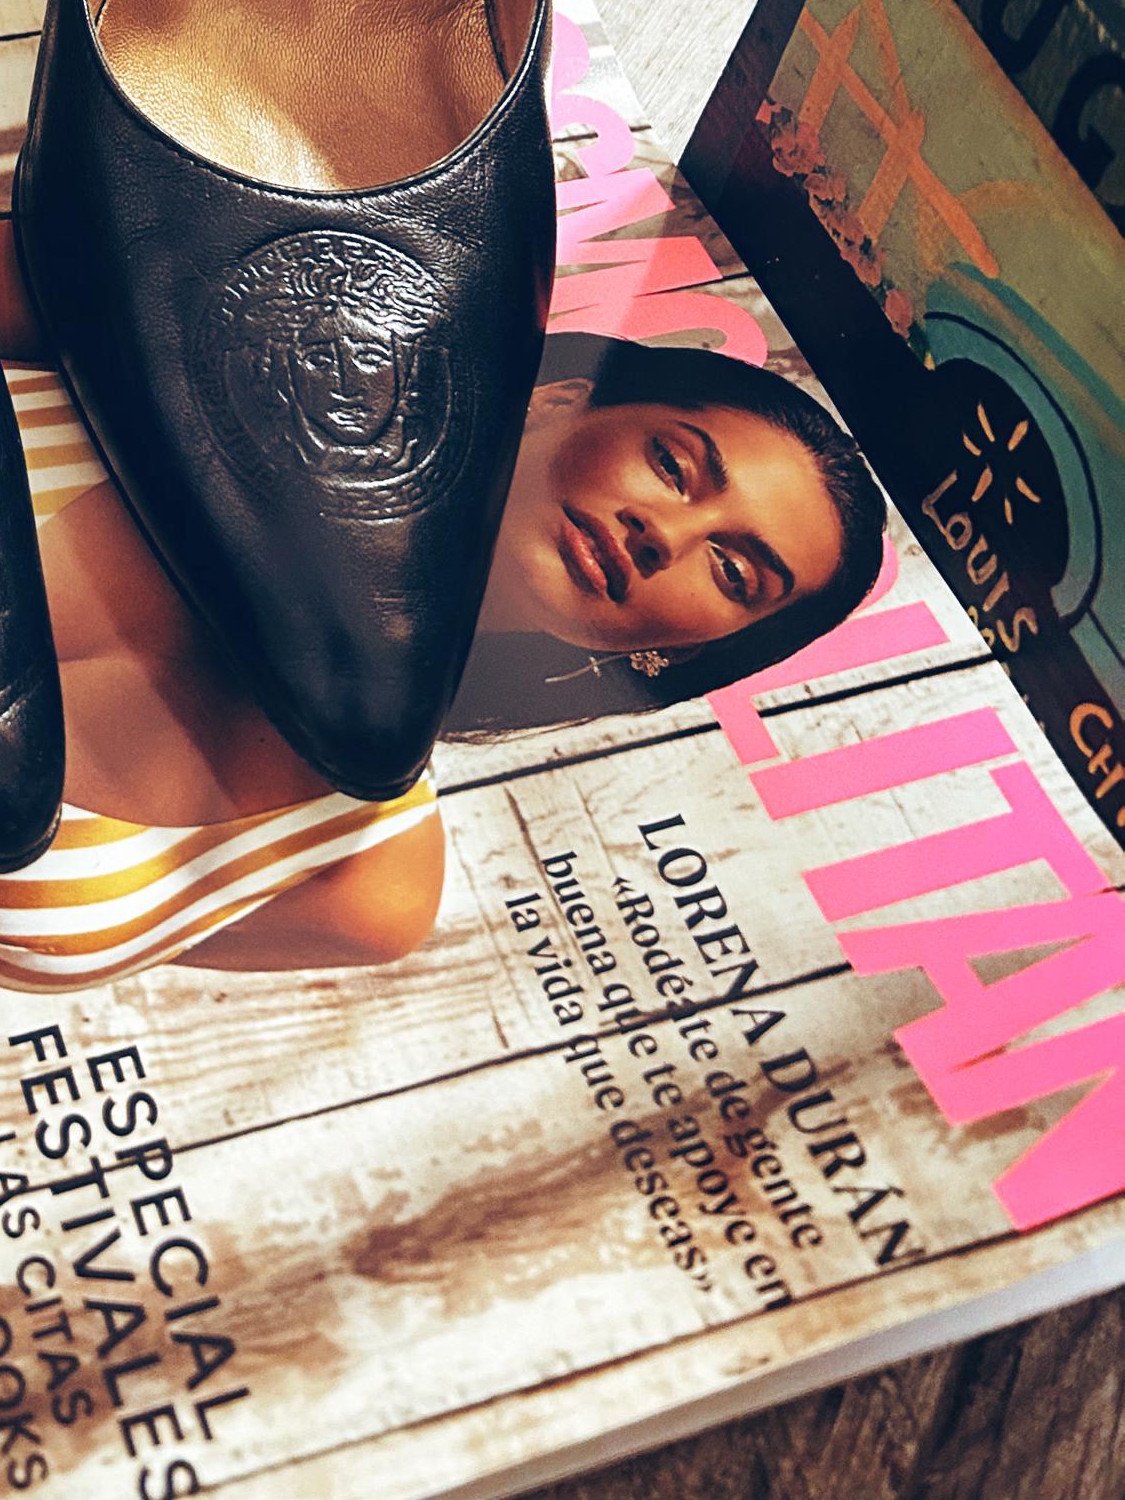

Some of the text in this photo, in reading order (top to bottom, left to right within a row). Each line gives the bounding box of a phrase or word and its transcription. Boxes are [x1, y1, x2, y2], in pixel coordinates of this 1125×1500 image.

[1070, 703, 1125, 828] CH
[504, 893, 714, 1293] la vida que deseas»
[541, 852, 792, 1309] buena que te apoye en
[638, 812, 926, 1265] LORENA DURÁN
[704, 1070, 749, 1121] de
[724, 1123, 825, 1250] gente
[8, 1024, 200, 1500] FESTIVALES
[16, 1256, 93, 1426] CITAS
[86, 1045, 251, 1441] ESPECIAL
